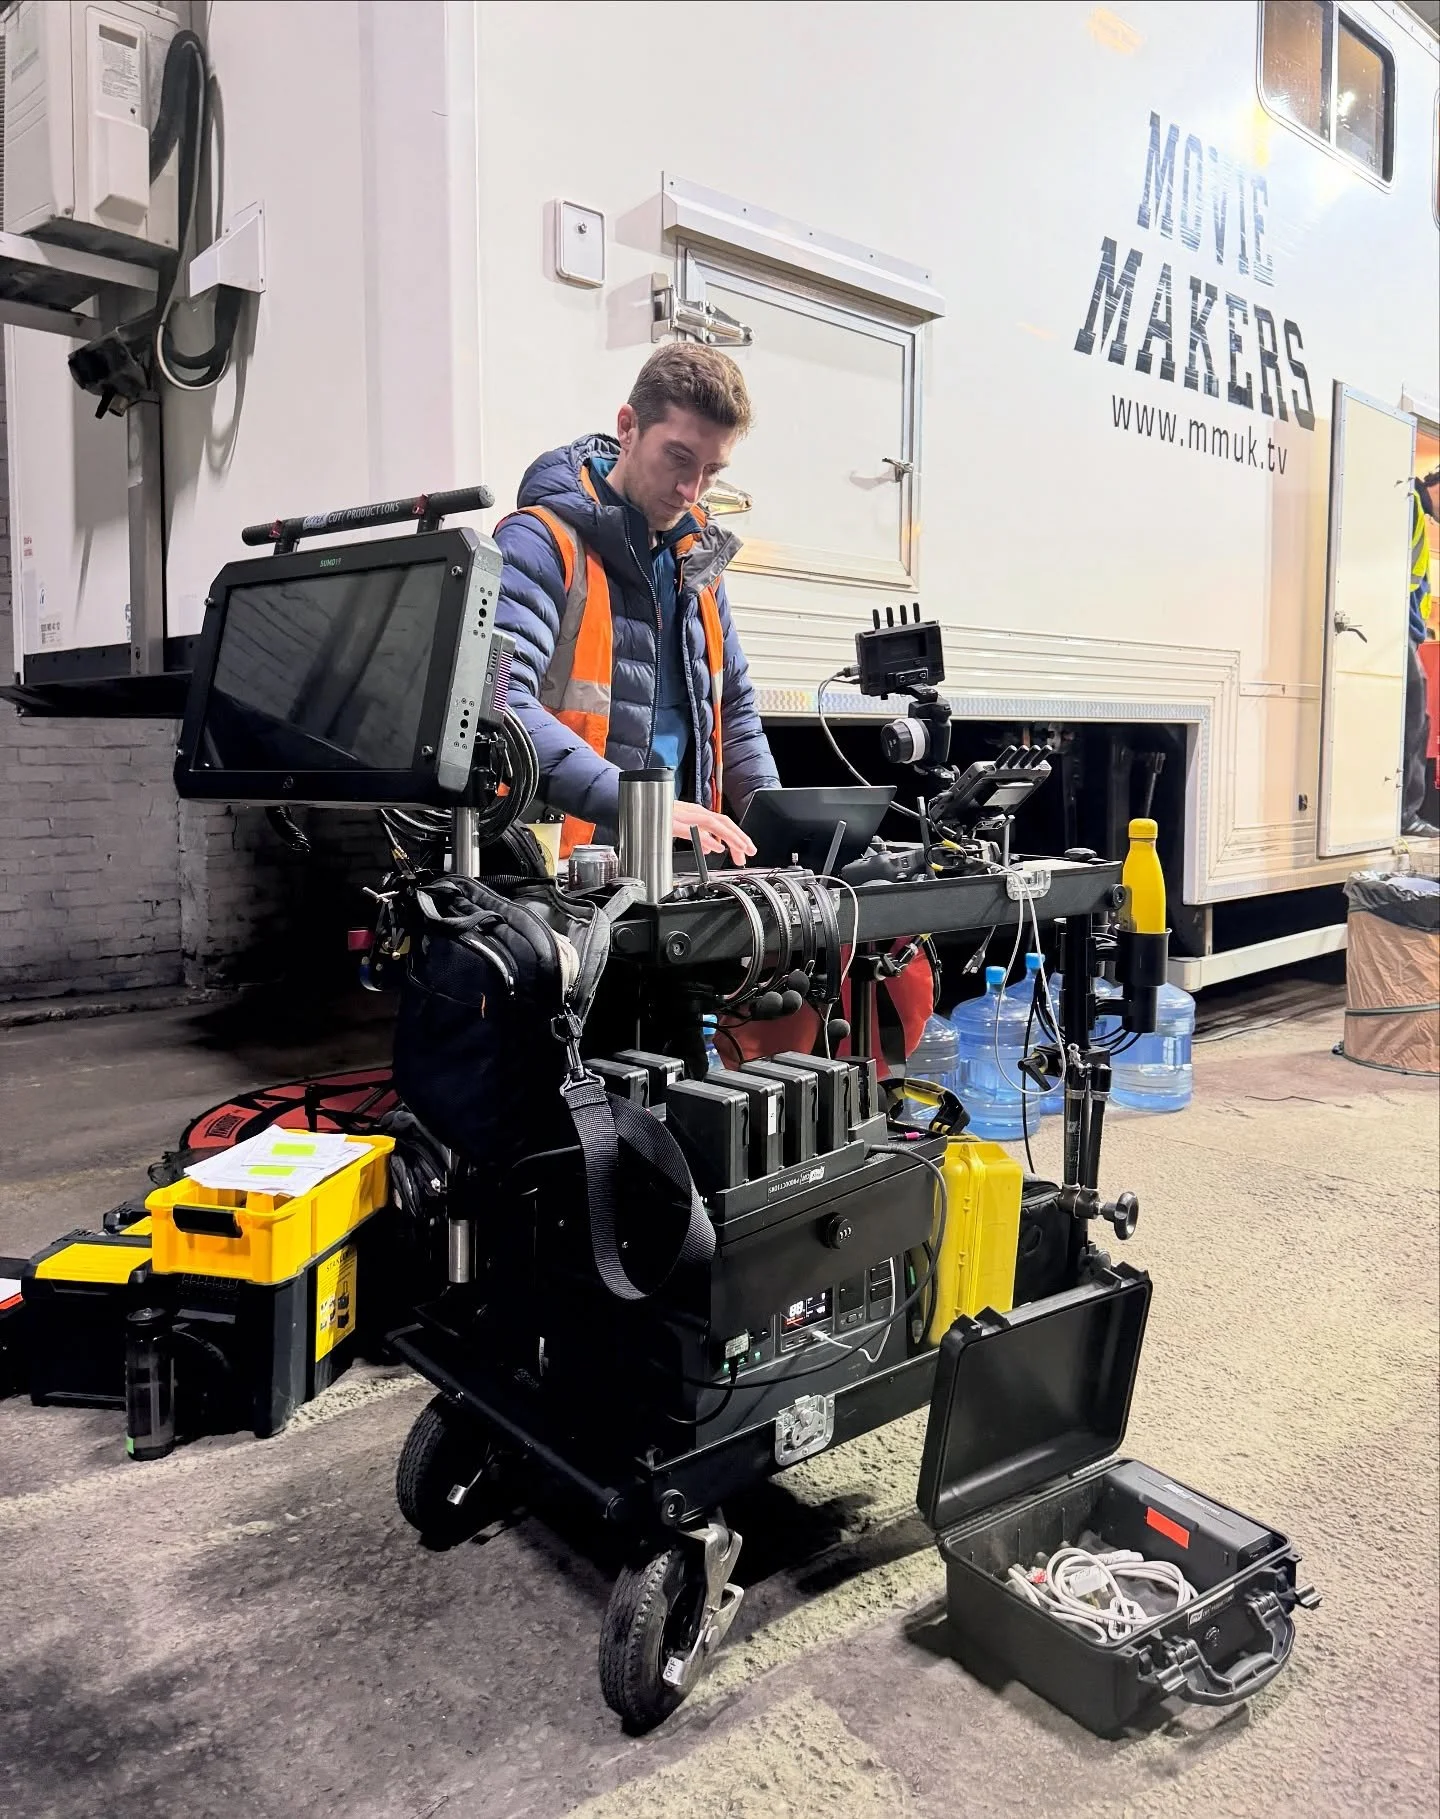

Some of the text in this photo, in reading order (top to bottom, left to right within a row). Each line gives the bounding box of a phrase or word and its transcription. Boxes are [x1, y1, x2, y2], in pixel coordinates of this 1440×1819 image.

[1137, 110, 1275, 287] MOVIE
[1074, 236, 1315, 431] MAKERS
[1112, 395, 1288, 475] www.mmuk.tv
[665, 1659, 676, 1678] OFF
